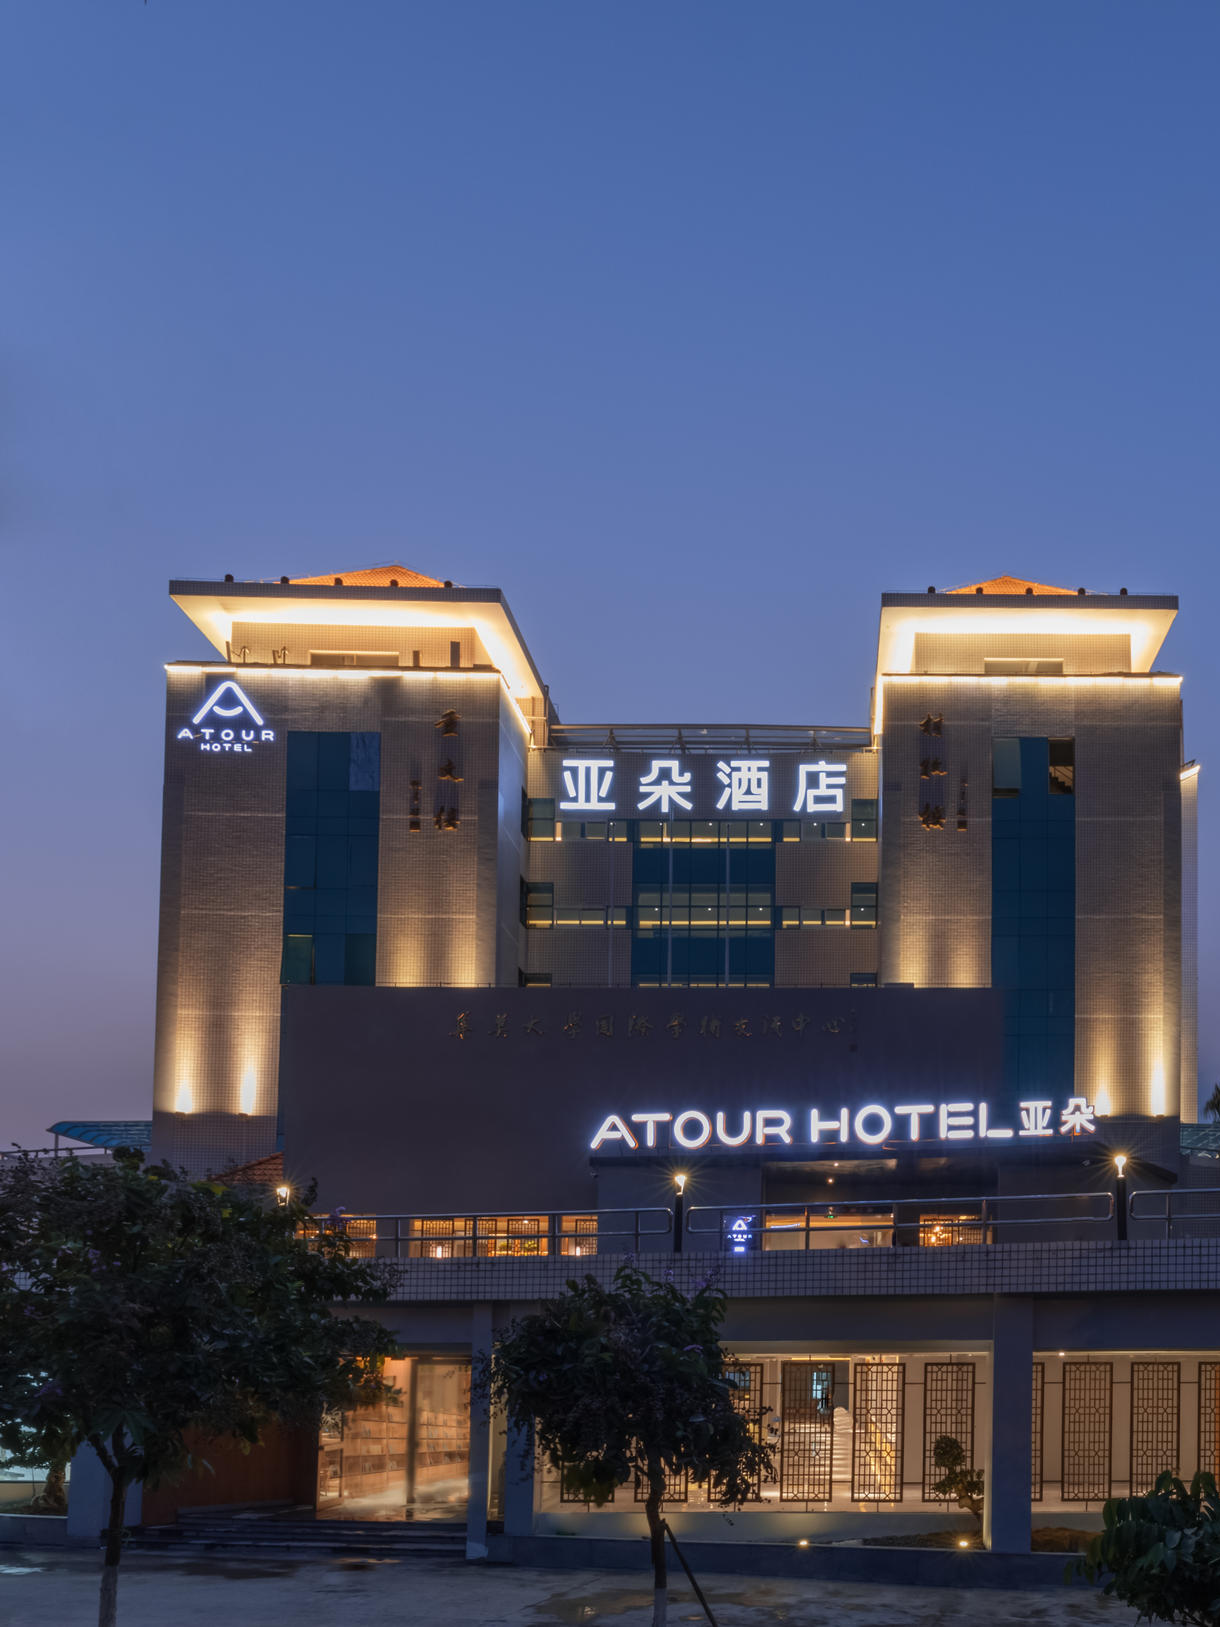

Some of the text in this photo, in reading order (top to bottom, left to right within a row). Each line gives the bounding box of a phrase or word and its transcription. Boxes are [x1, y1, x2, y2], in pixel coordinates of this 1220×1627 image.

[177, 728, 275, 742] ATOUR
[200, 743, 253, 752] HOTEL
[559, 759, 848, 813] 亚朵酒店
[590, 1097, 1096, 1149] ATOUR HOTEL 亚朵
